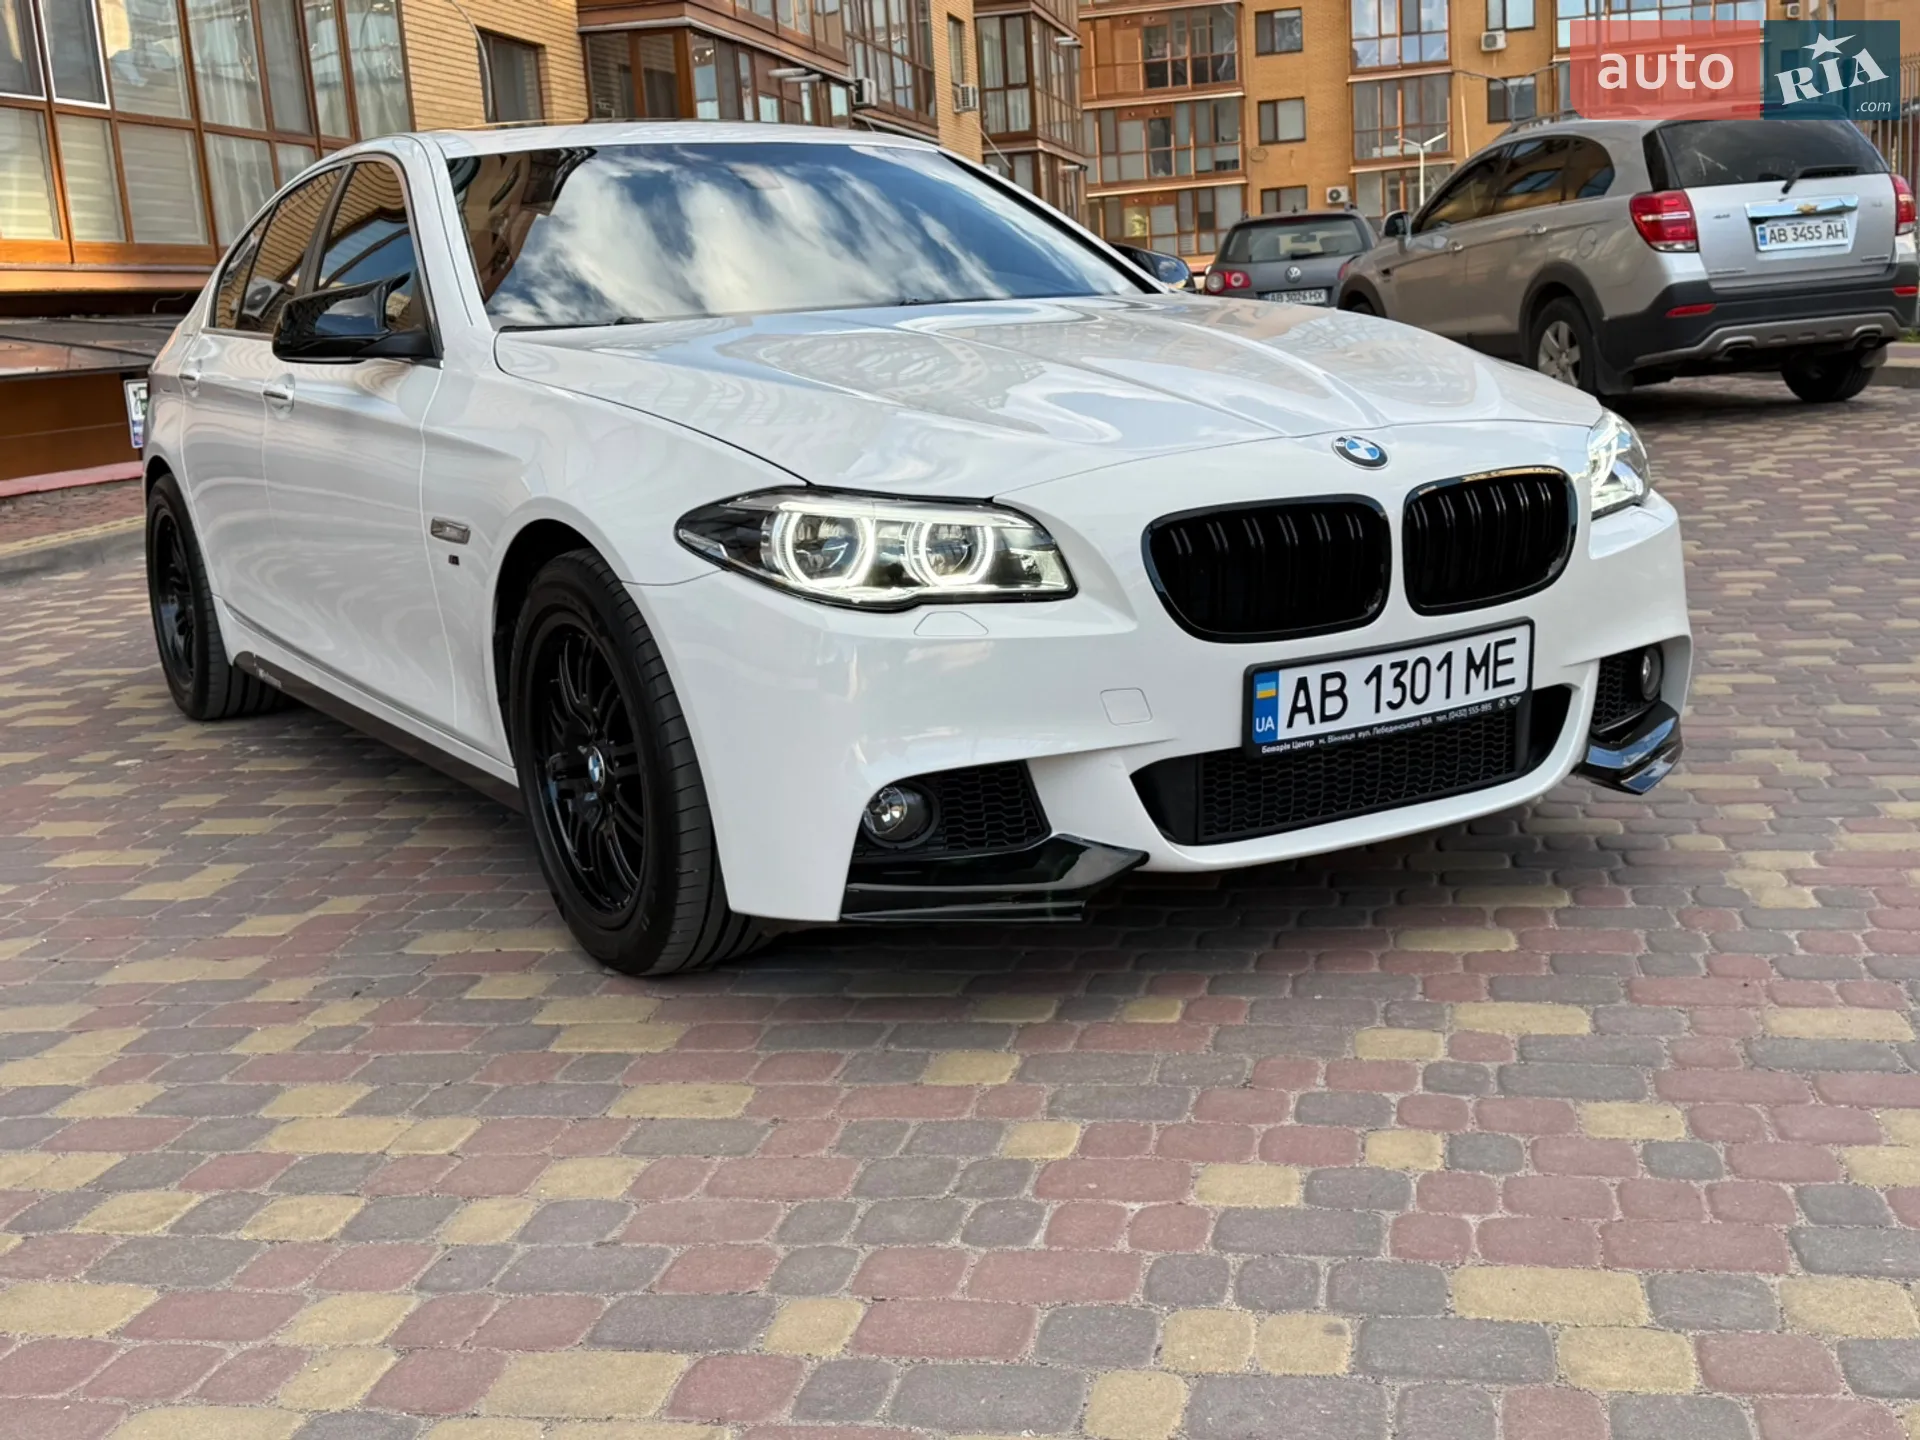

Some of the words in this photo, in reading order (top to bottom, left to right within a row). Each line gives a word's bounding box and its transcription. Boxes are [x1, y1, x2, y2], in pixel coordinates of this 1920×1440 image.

[1769, 227, 1788, 244] AB
[1791, 225, 1822, 242] 3455
[1826, 223, 1845, 239] AH
[1286, 672, 1348, 729] AB
[1364, 651, 1453, 714] 1301
[1465, 637, 1517, 696] ME
[1255, 716, 1275, 733] UA
